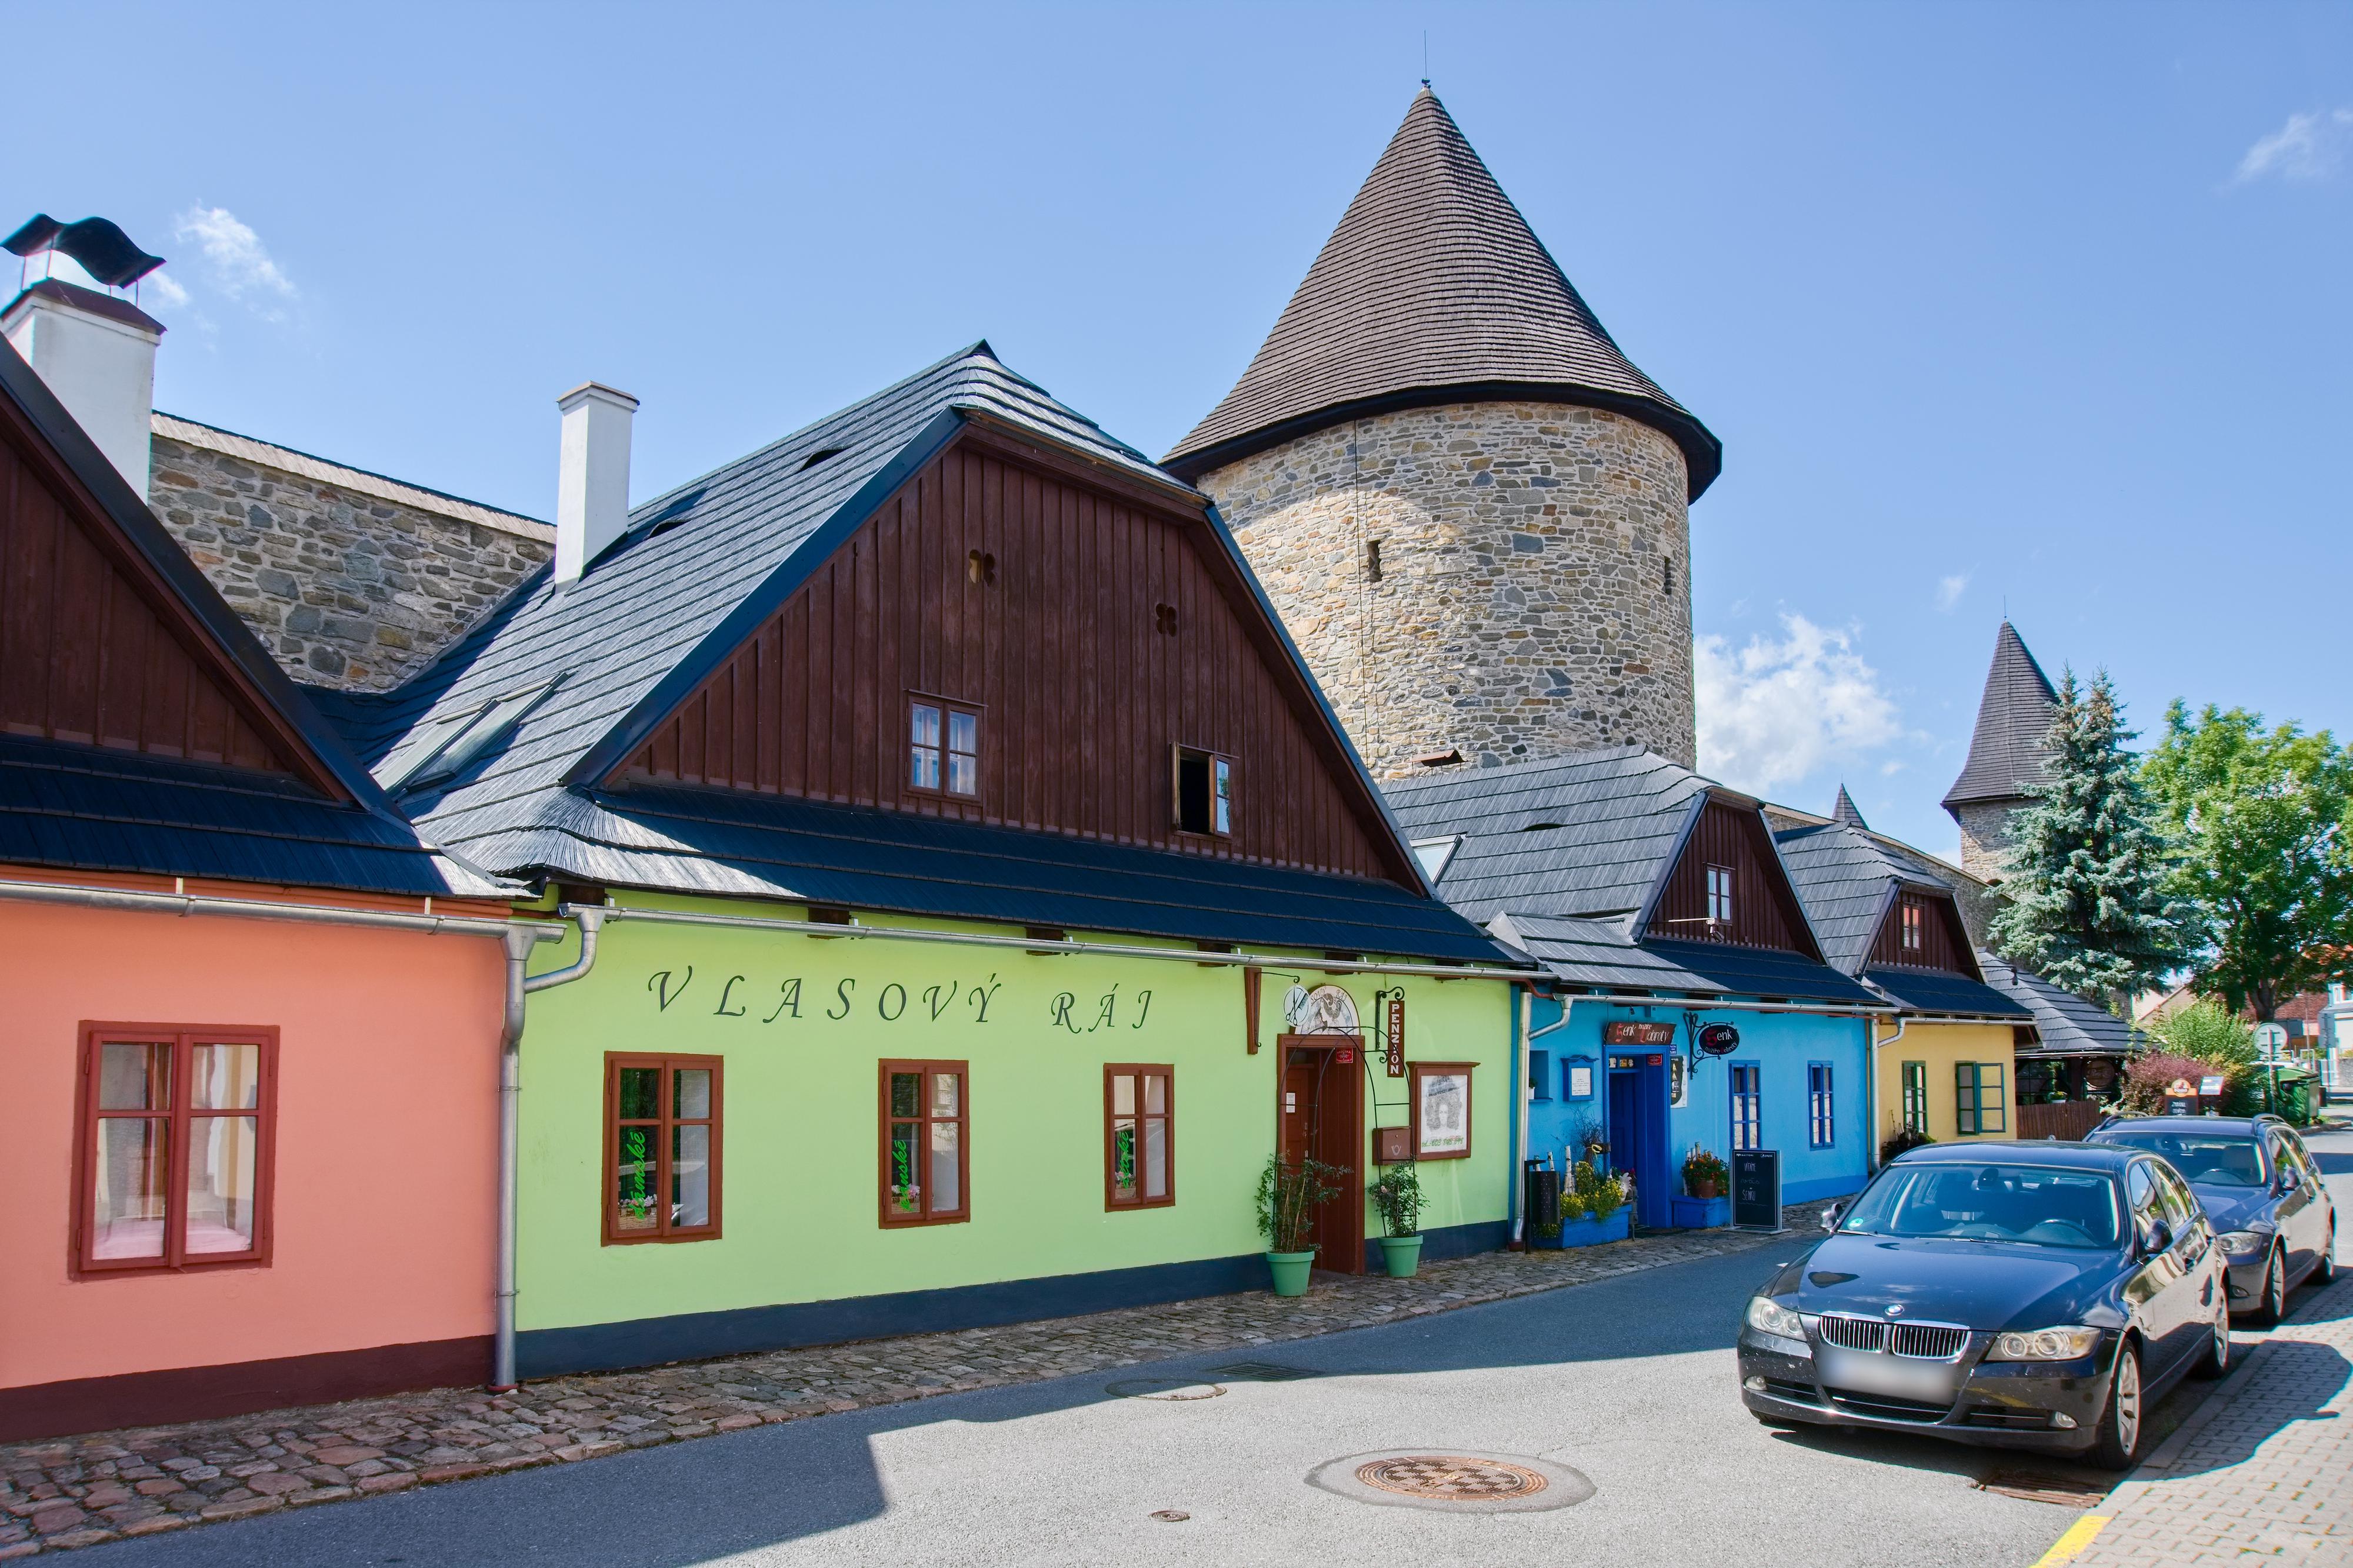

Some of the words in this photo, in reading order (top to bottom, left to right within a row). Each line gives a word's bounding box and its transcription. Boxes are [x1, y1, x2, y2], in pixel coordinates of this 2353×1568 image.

[648, 965, 1001, 1023] VLASOVÝ
[1051, 983, 1152, 1034] RÁJ
[1311, 986, 1327, 1003] SOVÝ
[1390, 1003, 1400, 1074] PENZION
[626, 1132, 645, 1220] dámské
[892, 1139, 913, 1212] pánské
